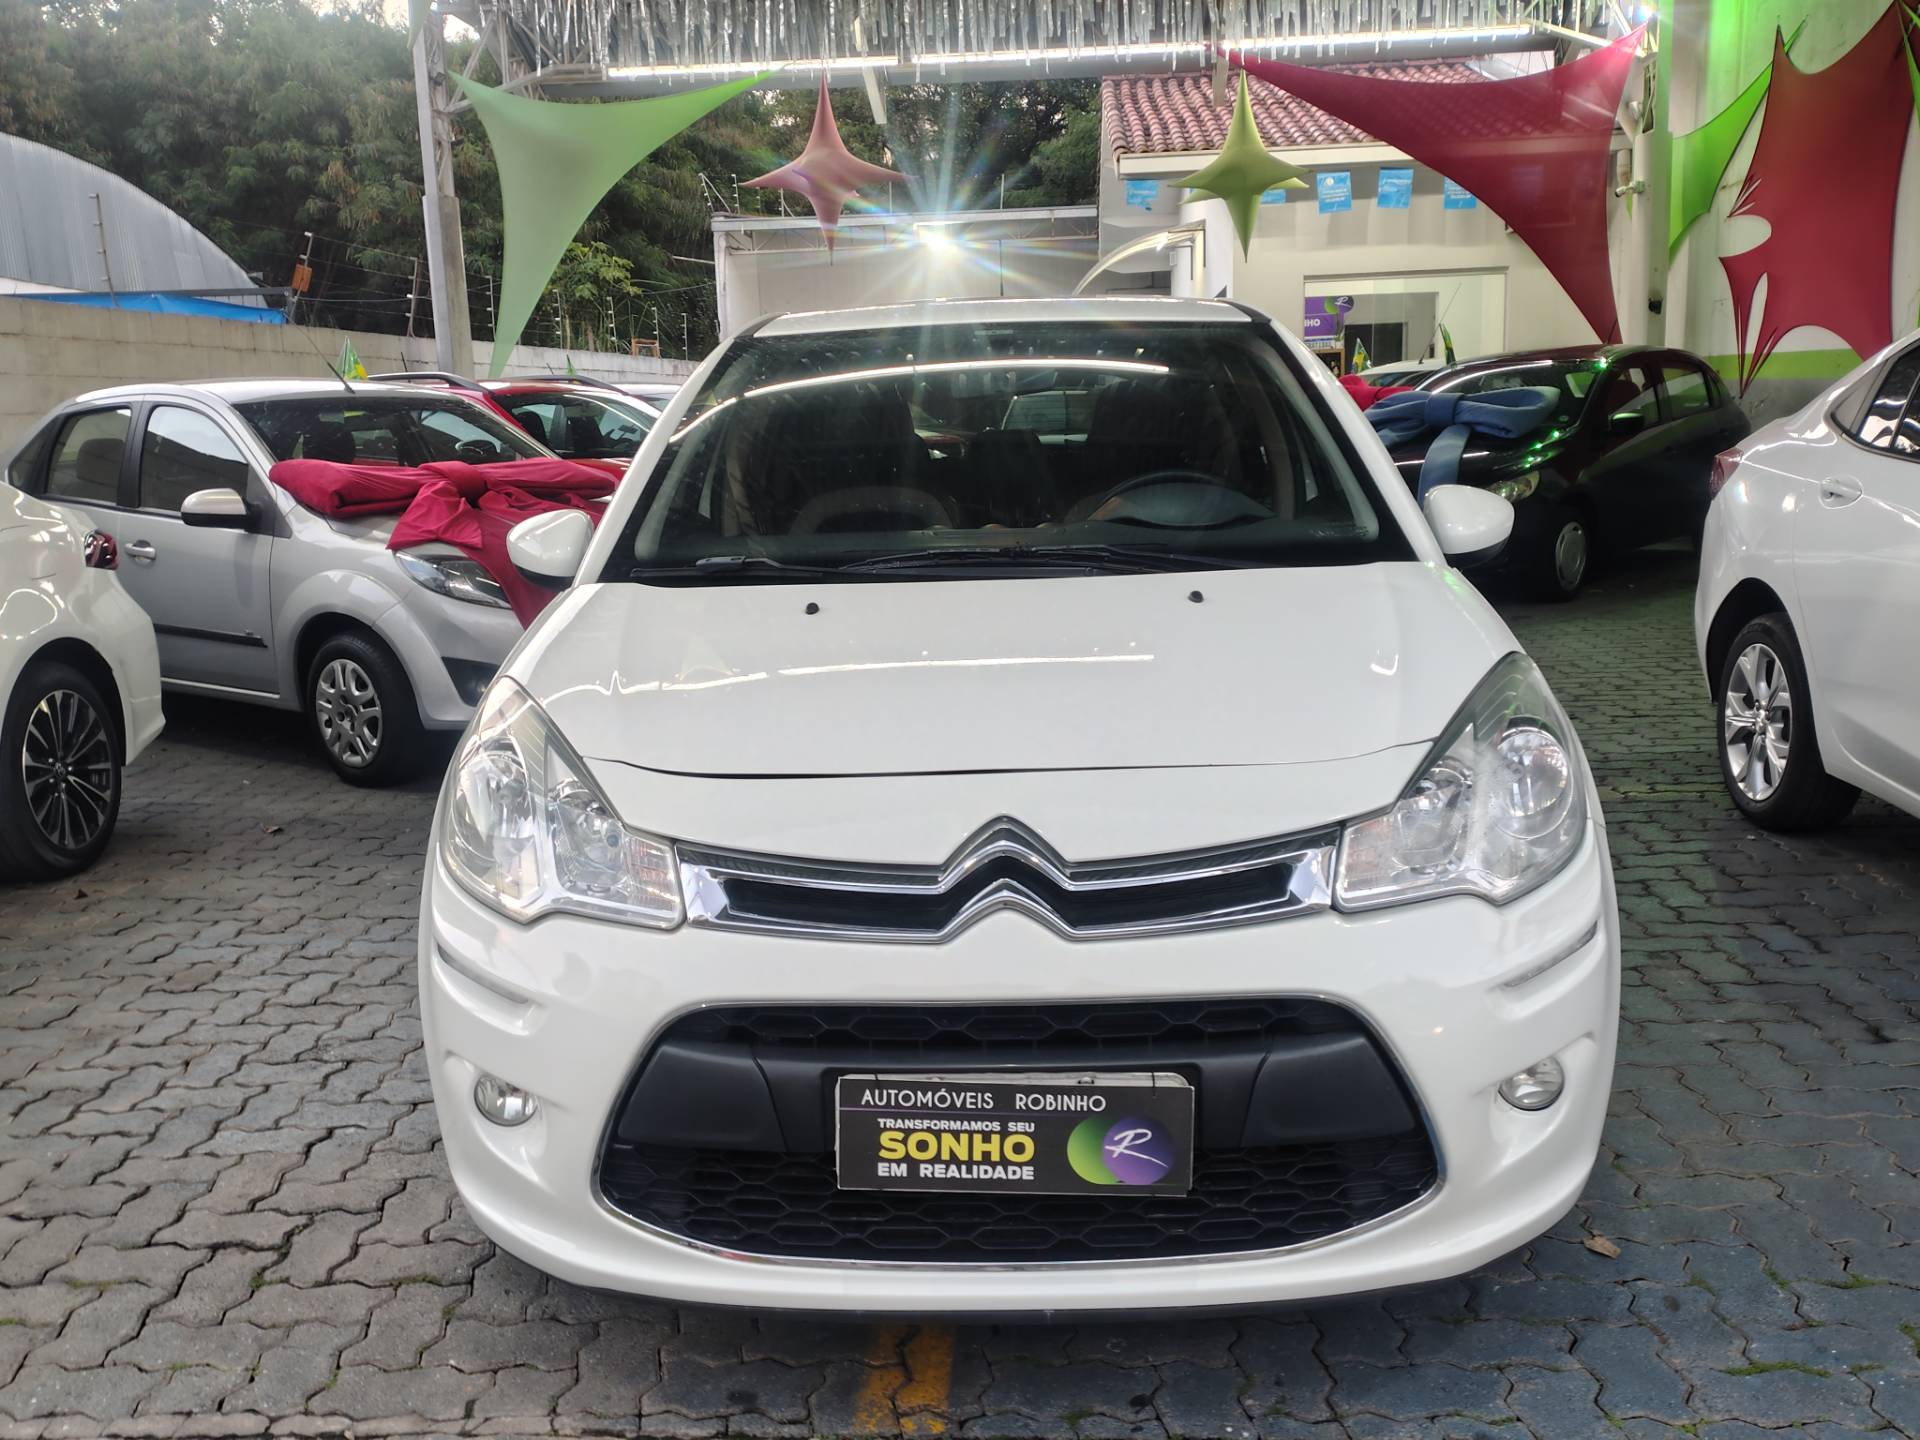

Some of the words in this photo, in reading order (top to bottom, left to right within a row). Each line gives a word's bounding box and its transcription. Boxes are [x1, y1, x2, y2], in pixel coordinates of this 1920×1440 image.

[861, 1088, 994, 1109] AUTOMÓVEIS
[1015, 1093, 1107, 1112] ROBINHO
[877, 1118, 1001, 1132] TRANSFORMAMOS
[1007, 1121, 1036, 1133] SEU
[878, 1130, 1035, 1163] SONHO
[1104, 1128, 1169, 1168] R
[877, 1162, 908, 1178] EM
[919, 1163, 1035, 1180] REALIDADE
